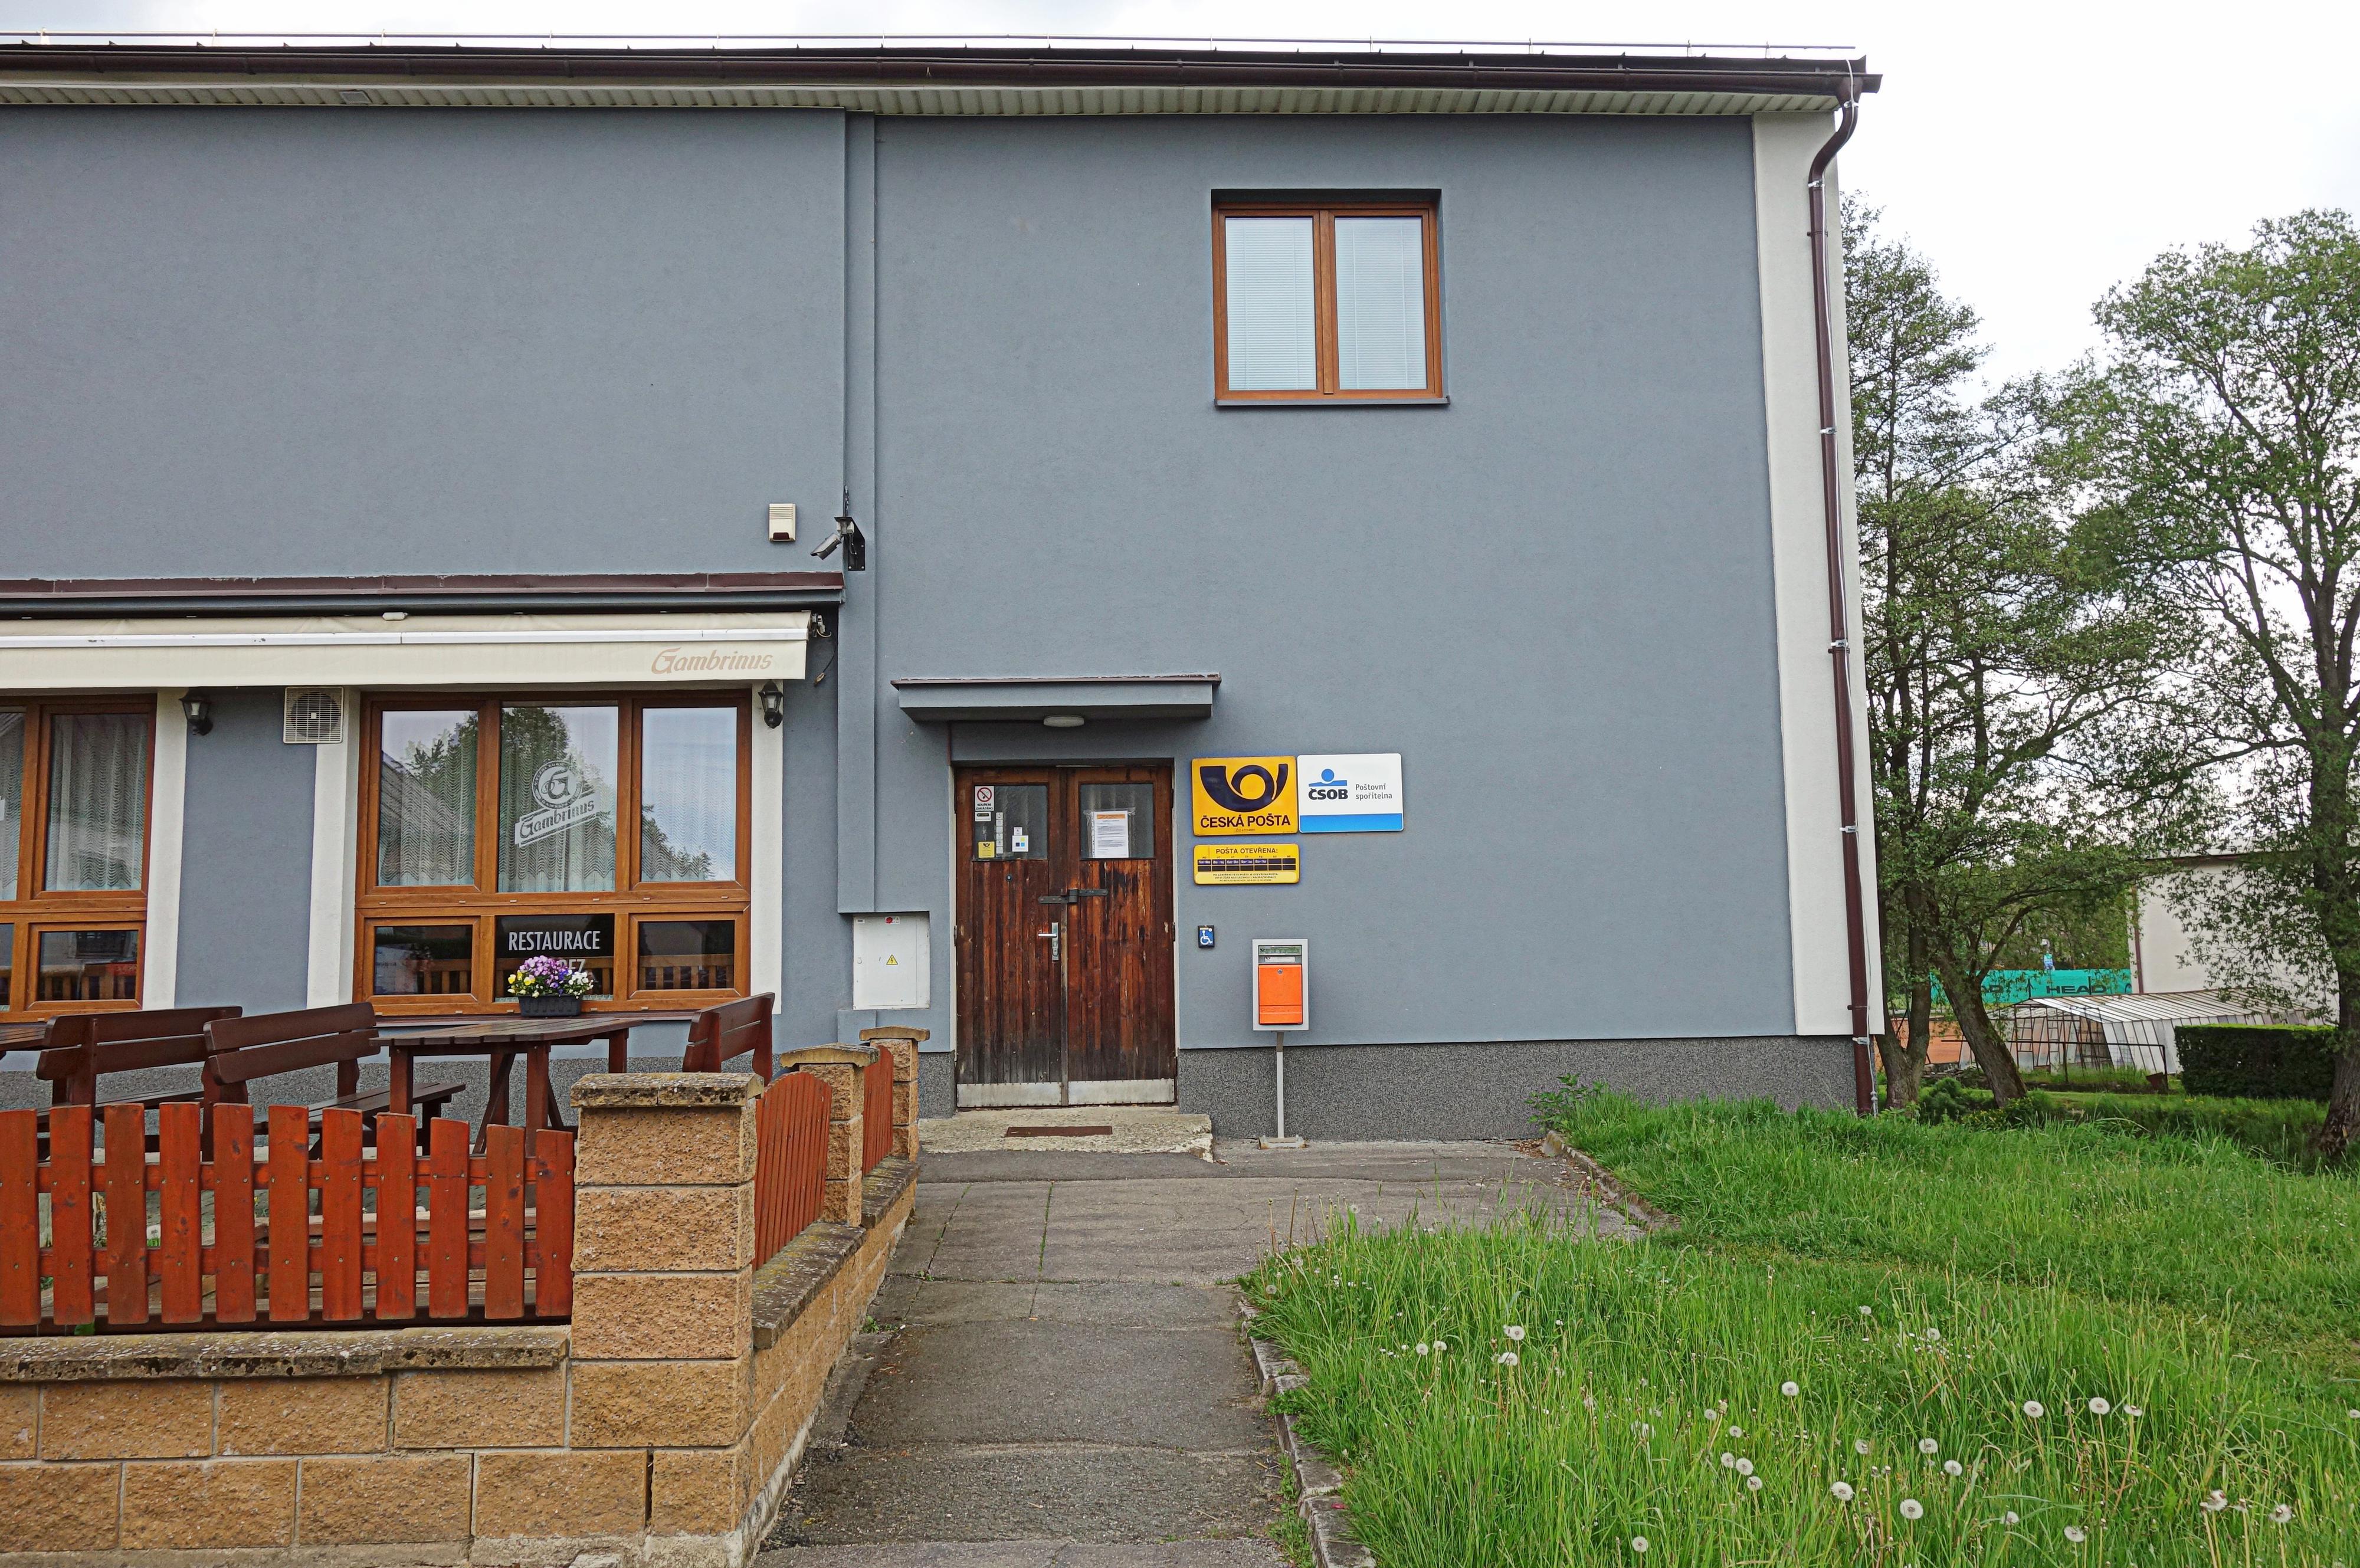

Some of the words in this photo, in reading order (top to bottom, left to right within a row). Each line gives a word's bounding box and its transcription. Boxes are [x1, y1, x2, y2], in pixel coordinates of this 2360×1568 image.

[651, 647, 773, 675] Gambrinus
[1308, 788, 1349, 801] ČSOB
[1355, 792, 1393, 801] spořitelna
[519, 800, 595, 839] Gambrinus
[1200, 814, 1245, 828] ČESKÁ
[1247, 813, 1291, 827] POŠTA
[509, 931, 601, 951] RESTAURACE
[2046, 985, 2107, 994] HEAD
